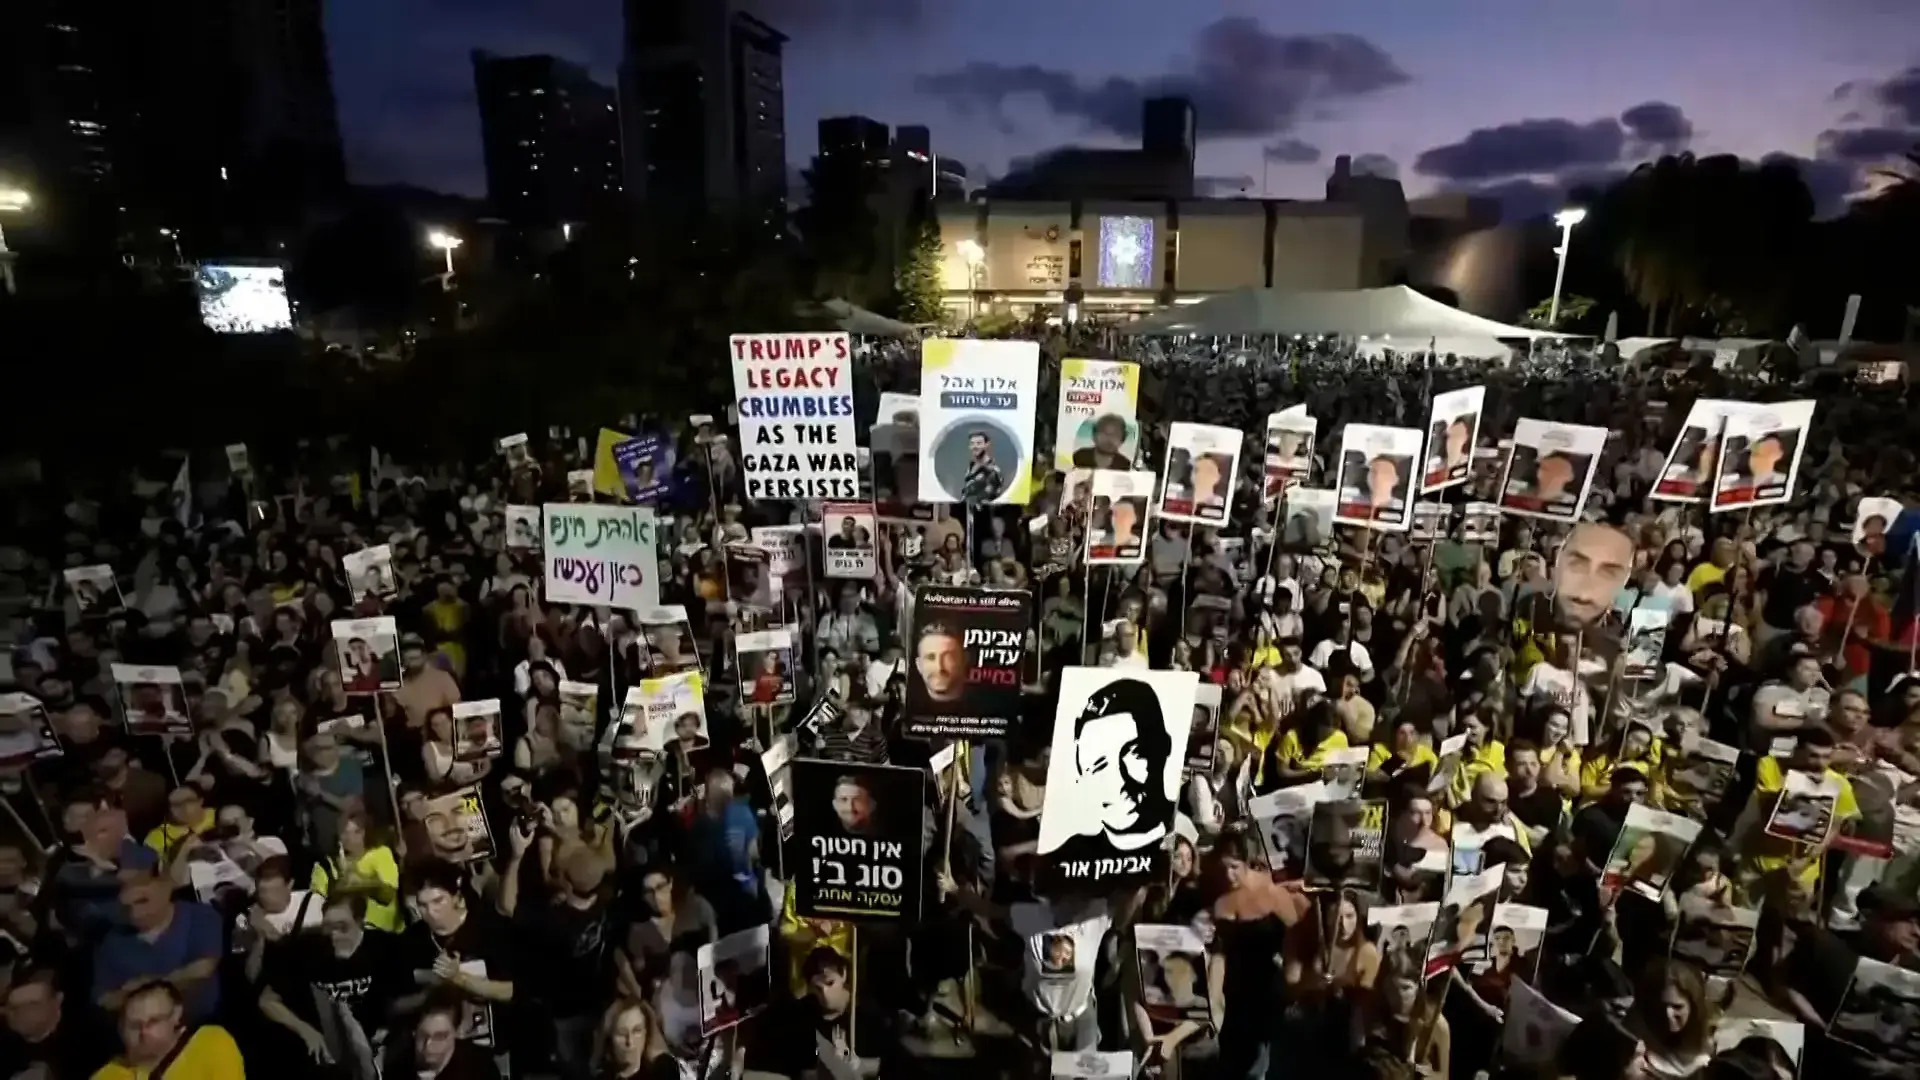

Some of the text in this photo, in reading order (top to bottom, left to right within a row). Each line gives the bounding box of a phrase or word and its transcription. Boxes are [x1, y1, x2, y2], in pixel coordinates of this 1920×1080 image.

[733, 337, 847, 360] TRUMP'S
[747, 367, 838, 389] LEGACY
[941, 374, 1017, 392] אלון אהל
[1068, 375, 1125, 392] אלון אהל
[738, 395, 853, 417] CRUMBLES
[996, 396, 1011, 406] עד
[756, 424, 837, 444] AS THE
[743, 453, 856, 472] GAZA WAR
[748, 478, 855, 498] PERSISTS
[550, 511, 649, 548] אהבת חינם
[554, 557, 643, 601] כאן ועכשיו
[969, 596, 977, 604] is
[979, 596, 996, 605] still
[963, 629, 1022, 648] אבינתן
[978, 649, 1020, 667] עדיין
[969, 668, 1016, 684] בחיים
[811, 835, 902, 861] אין חטוף
[855, 863, 903, 890] סוג
[1059, 856, 1151, 880] אבינתן אור
[857, 891, 903, 908] עסקה
